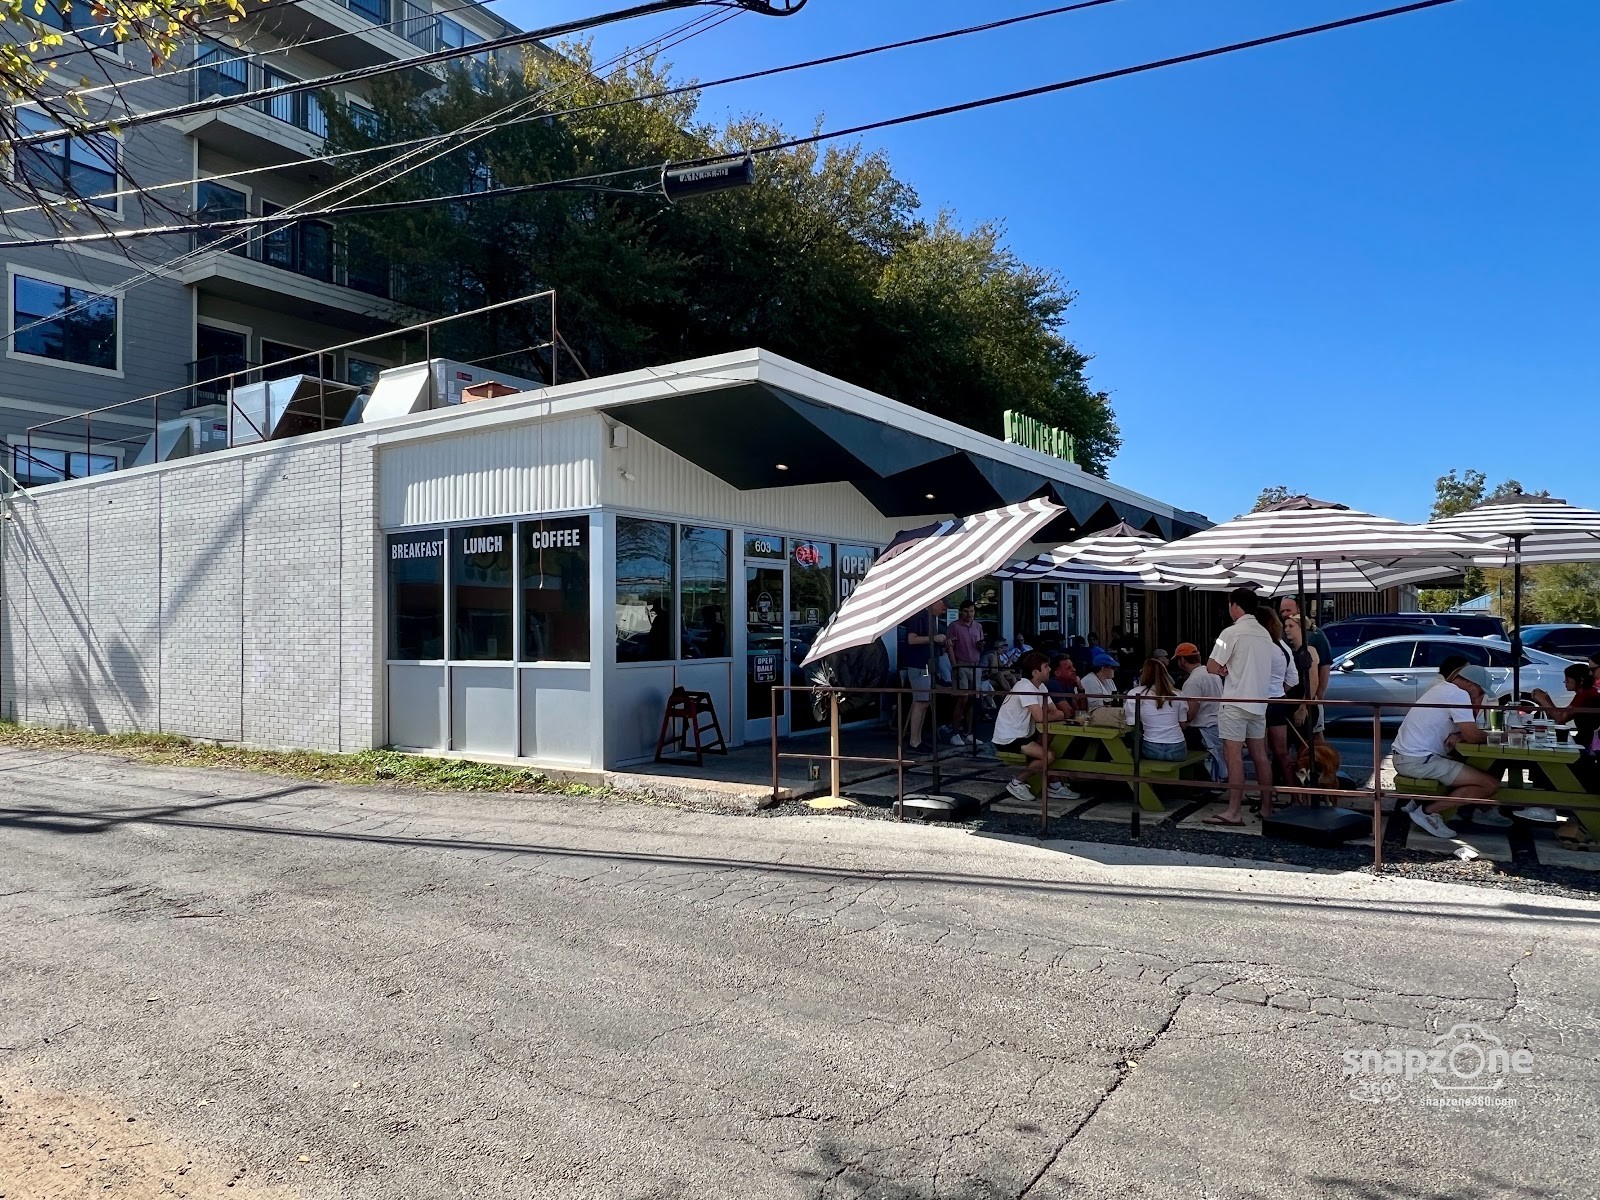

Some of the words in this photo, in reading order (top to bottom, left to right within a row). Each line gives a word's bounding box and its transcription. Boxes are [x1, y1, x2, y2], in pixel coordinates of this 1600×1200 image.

[463, 535, 503, 554] LUNCH
[532, 528, 580, 549] COFFEE
[755, 540, 771, 553] 603
[391, 540, 444, 560] BREAKFAST
[756, 664, 773, 672] DAILY
[757, 657, 773, 665] OPEN
